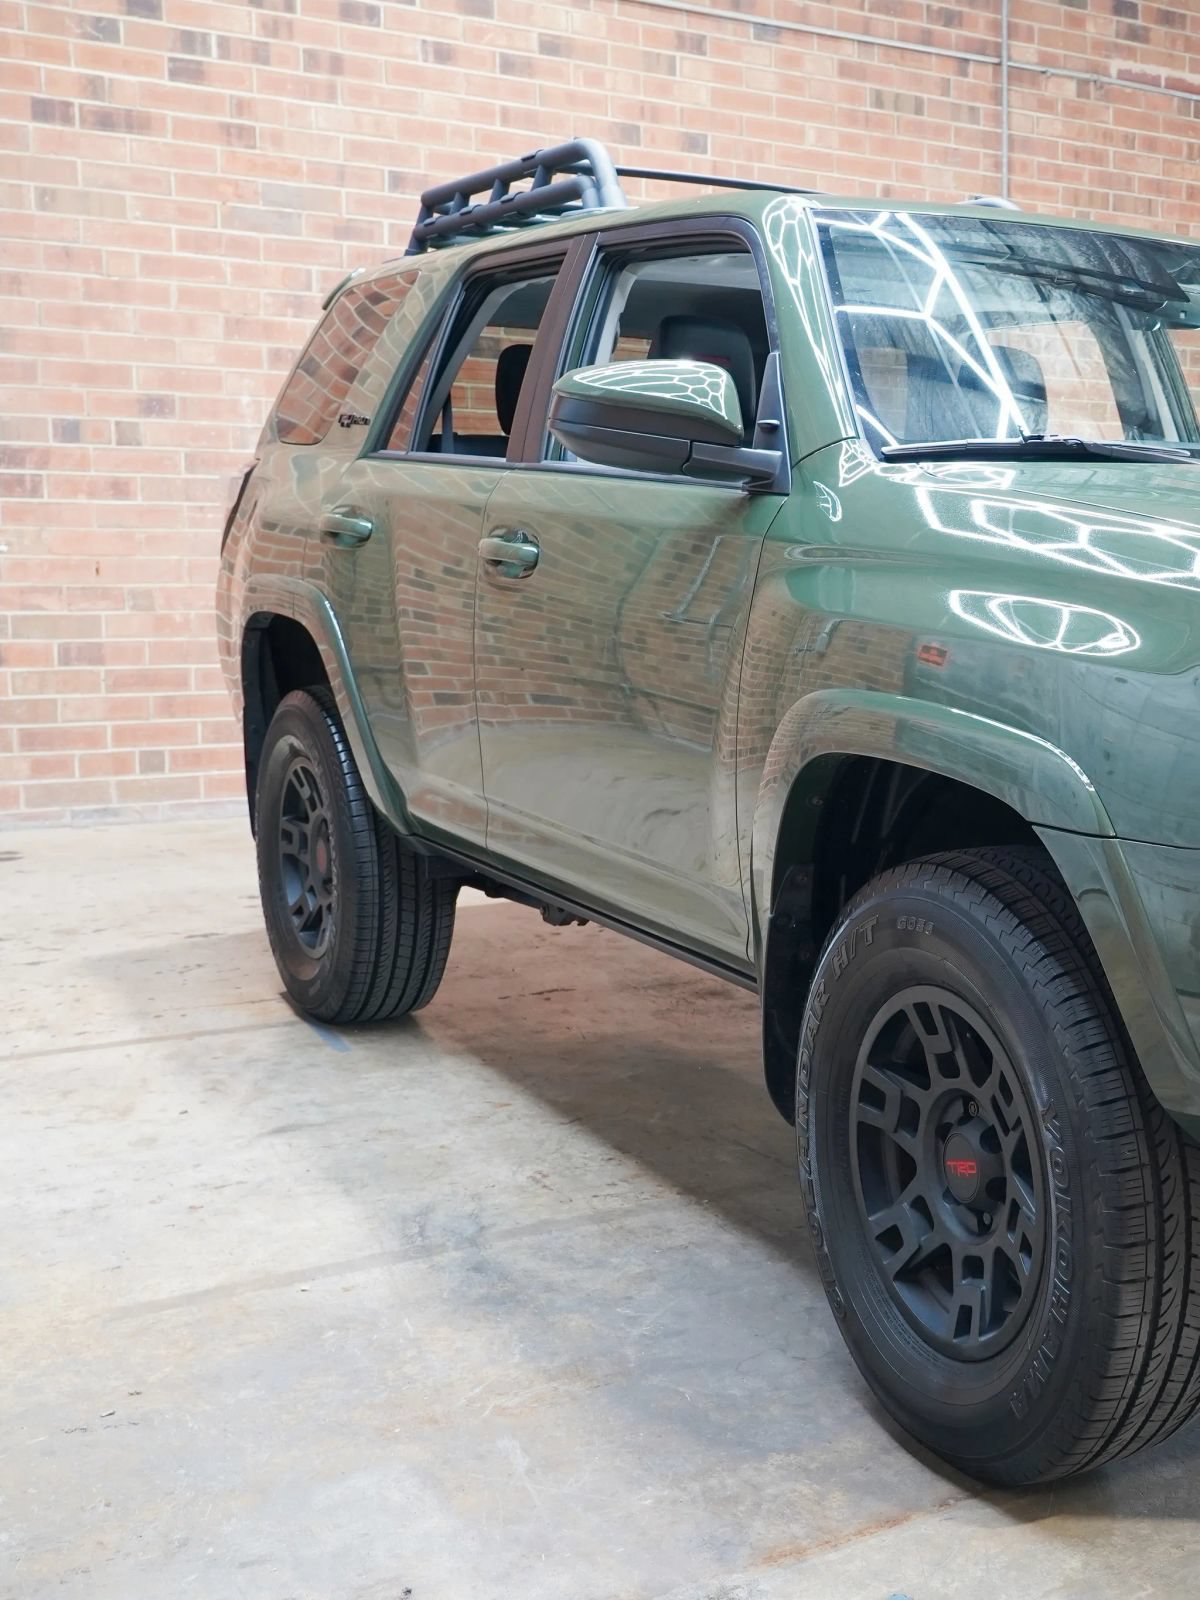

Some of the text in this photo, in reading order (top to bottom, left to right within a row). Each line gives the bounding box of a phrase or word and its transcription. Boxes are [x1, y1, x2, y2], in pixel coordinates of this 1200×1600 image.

[831, 915, 879, 981] H/T
[946, 1160, 977, 1177] TRD
[1010, 1099, 1073, 1420] YOKOHAMA
